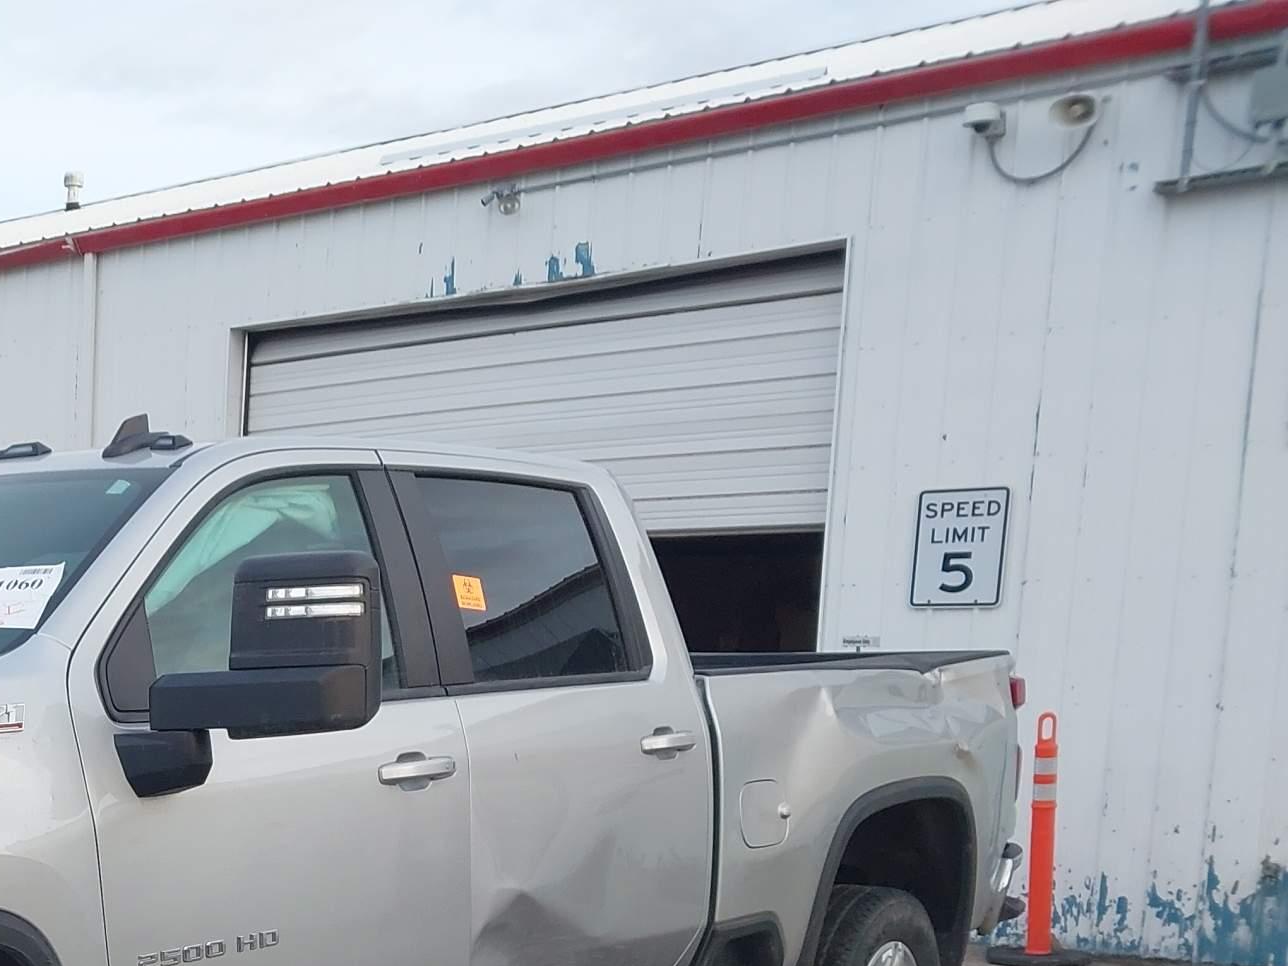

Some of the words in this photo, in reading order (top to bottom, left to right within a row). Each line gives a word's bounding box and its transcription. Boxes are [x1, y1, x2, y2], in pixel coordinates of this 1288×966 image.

[925, 500, 1002, 519] SPEED
[930, 526, 991, 544] LIMIT
[938, 551, 974, 593] 5
[236, 928, 280, 953] HD
